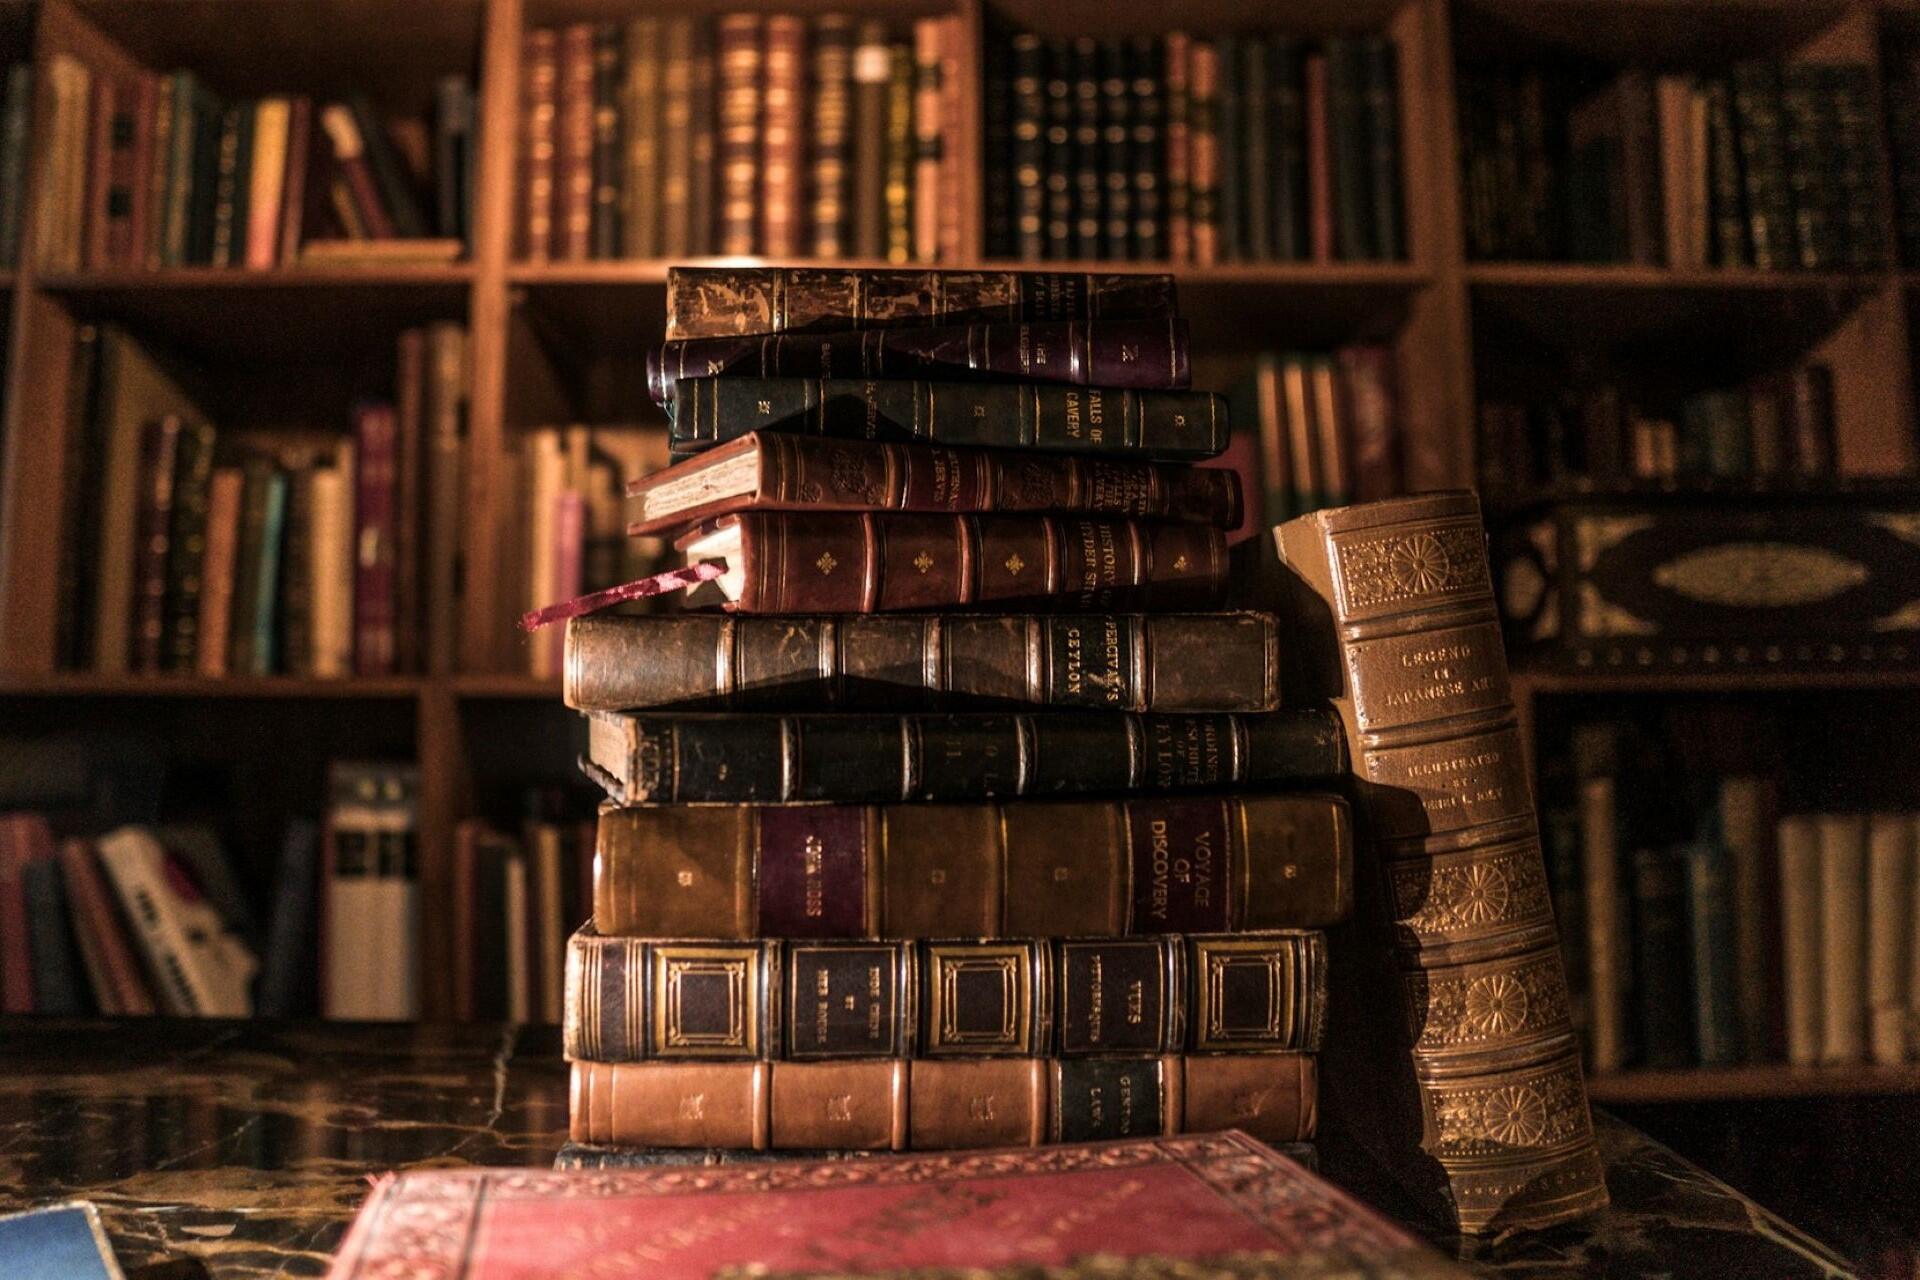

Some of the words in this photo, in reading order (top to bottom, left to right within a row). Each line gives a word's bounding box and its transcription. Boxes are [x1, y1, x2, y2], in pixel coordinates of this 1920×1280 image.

[1066, 392, 1080, 438] CAVERY
[1088, 390, 1102, 425] FALLS
[1089, 428, 1102, 445] OF
[1098, 524, 1116, 586] HISTORY
[1067, 629, 1081, 694] CEYLON
[1385, 681, 1465, 706] JAPANESE
[1151, 820, 1169, 920] DISCOVERY
[1174, 858, 1191, 884] OF
[1194, 832, 1211, 909] VOYAGE
[1127, 979, 1142, 1025] VUES
